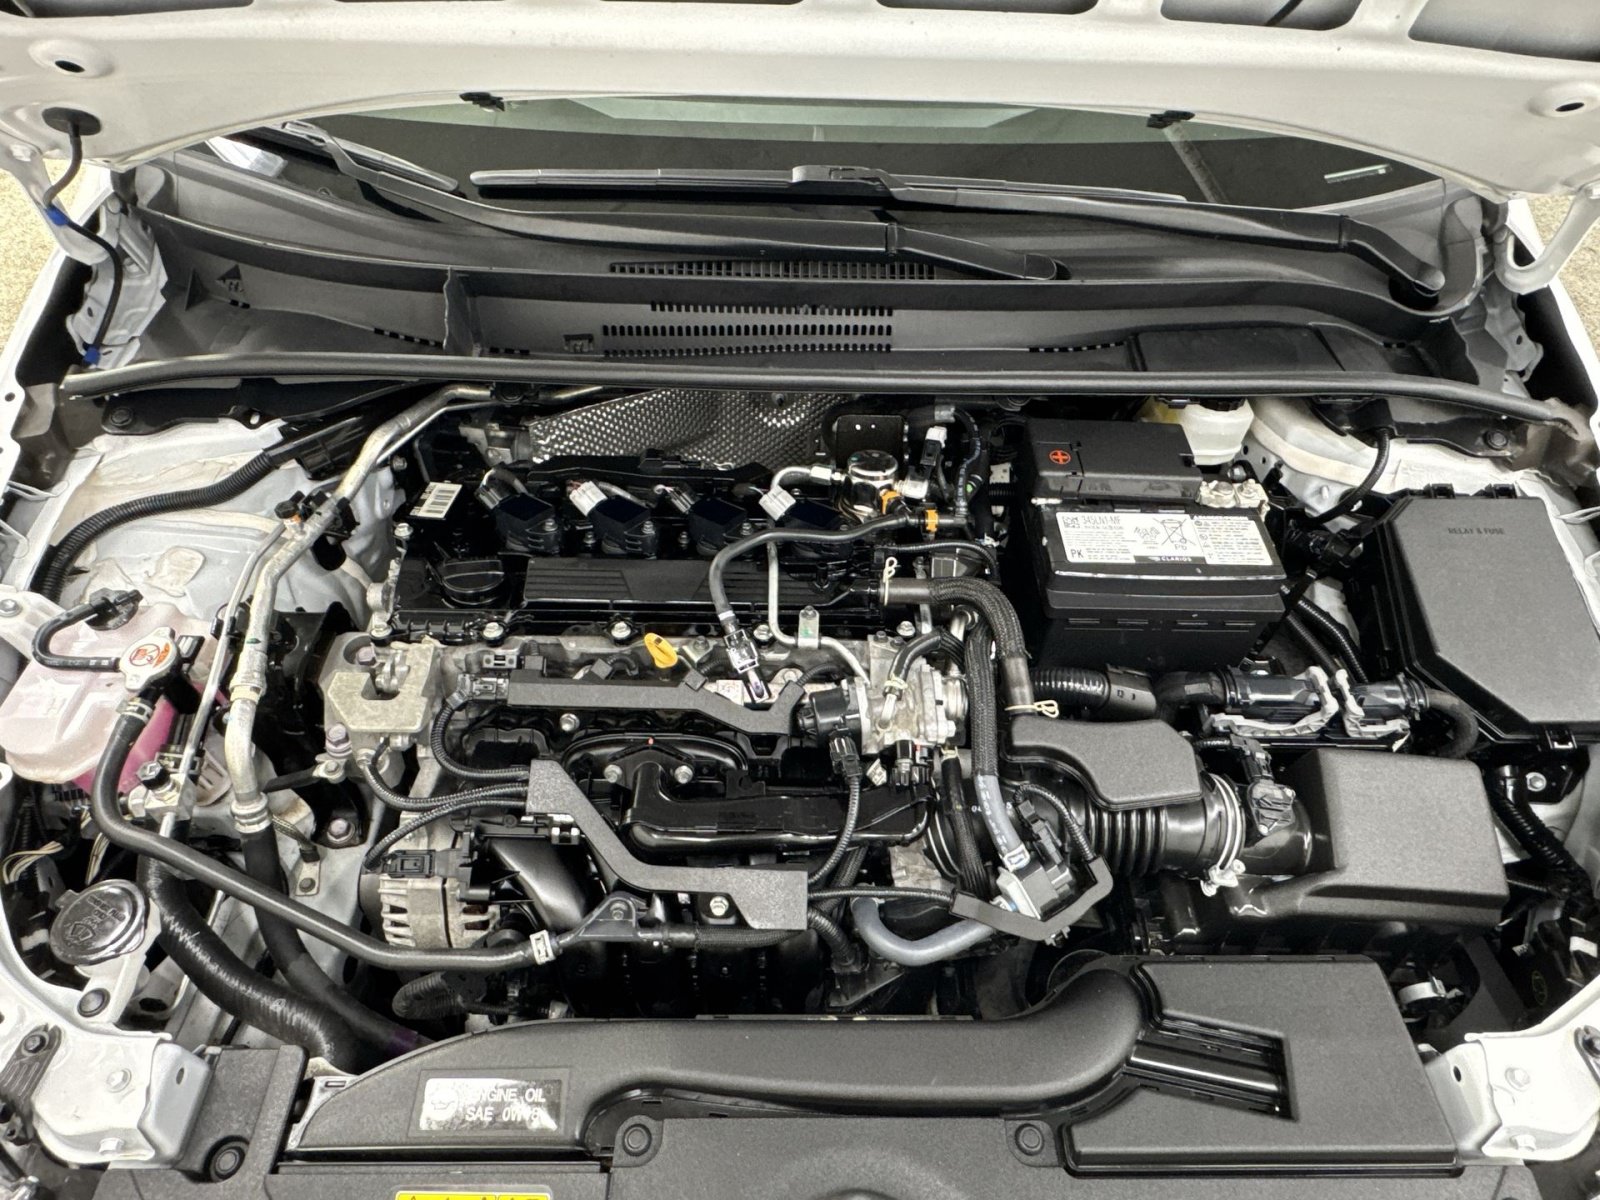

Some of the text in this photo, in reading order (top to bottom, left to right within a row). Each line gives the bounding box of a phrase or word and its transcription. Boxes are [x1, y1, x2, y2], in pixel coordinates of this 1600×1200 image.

[1447, 527, 1505, 535] RELAY & FUSE
[1070, 549, 1084, 559] PK
[525, 1088, 546, 1103] OIL
[465, 1106, 495, 1122] SAE
